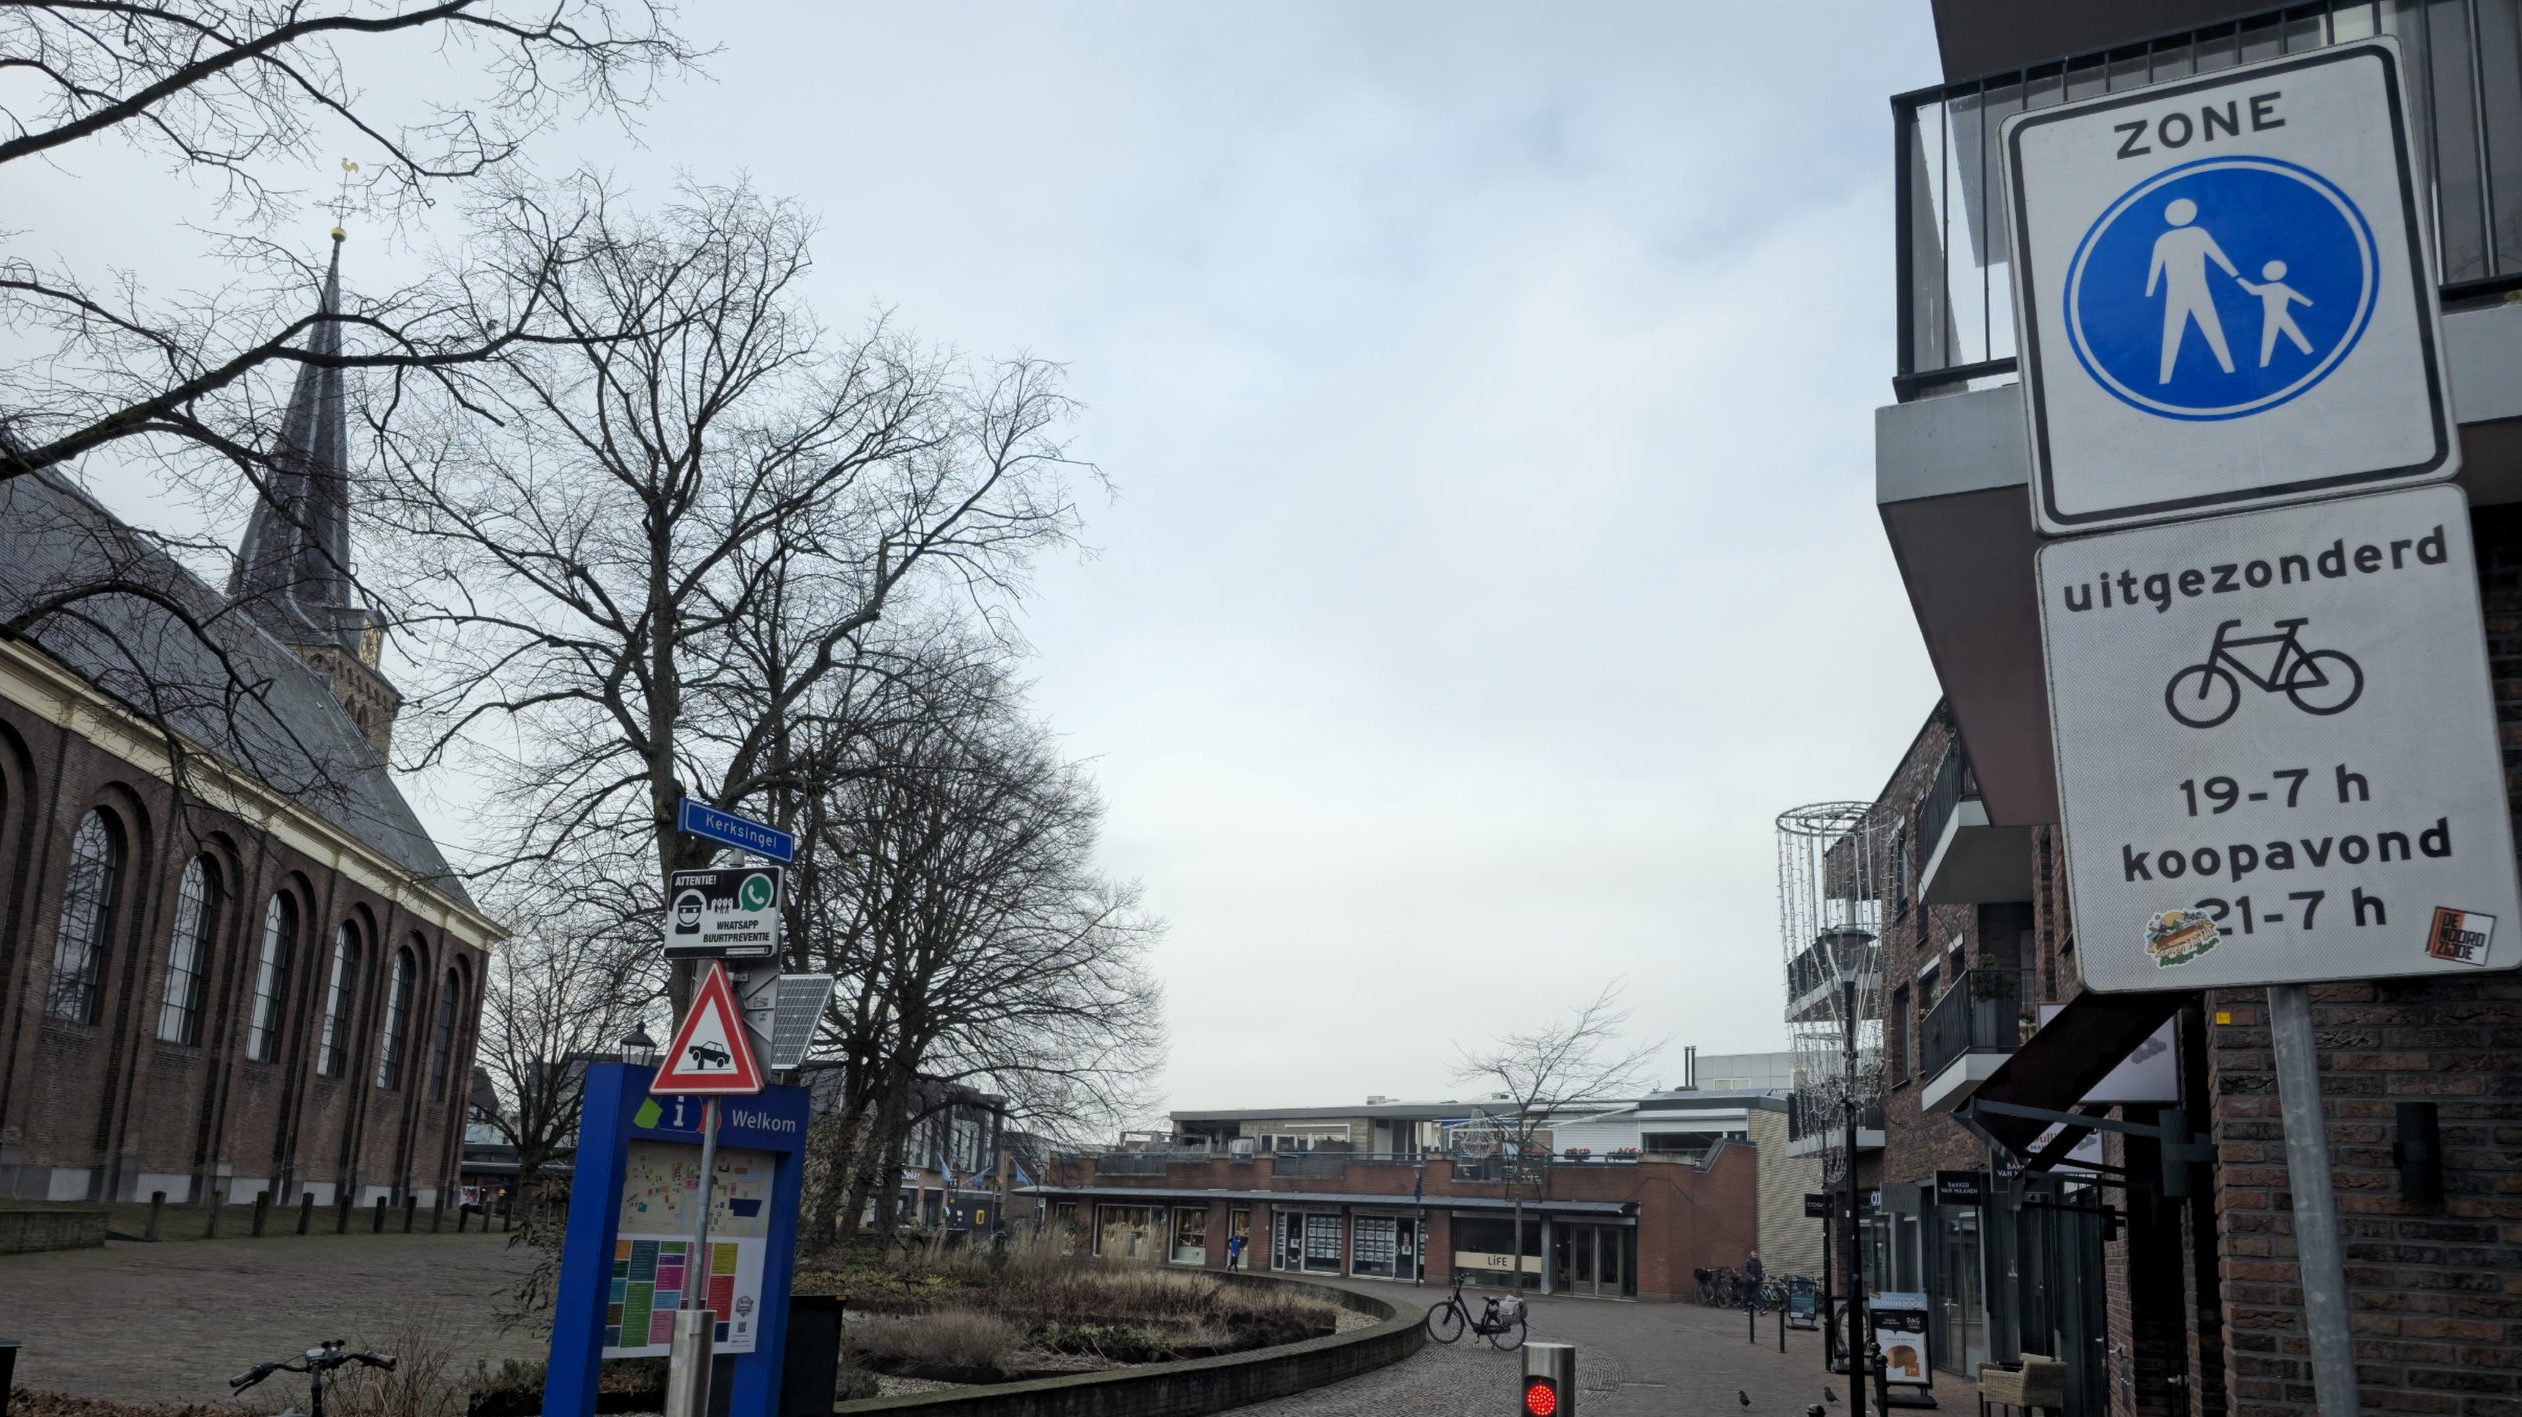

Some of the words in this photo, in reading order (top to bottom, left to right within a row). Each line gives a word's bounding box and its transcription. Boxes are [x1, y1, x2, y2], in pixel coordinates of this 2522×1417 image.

[2113, 91, 2286, 160] ZONE
[2063, 524, 2449, 613] uitgezonderd
[2179, 768, 2310, 818] 19-7
[2335, 763, 2370, 804] h
[705, 813, 778, 849] Kerksingel
[2122, 816, 2452, 882] koopavond
[674, 875, 718, 887] ATTENTIE!
[716, 919, 759, 931] WHATSAPP
[2352, 886, 2387, 928] h
[702, 932, 770, 943] BUURTPREVENTIE
[731, 1109, 797, 1133] Welkom
